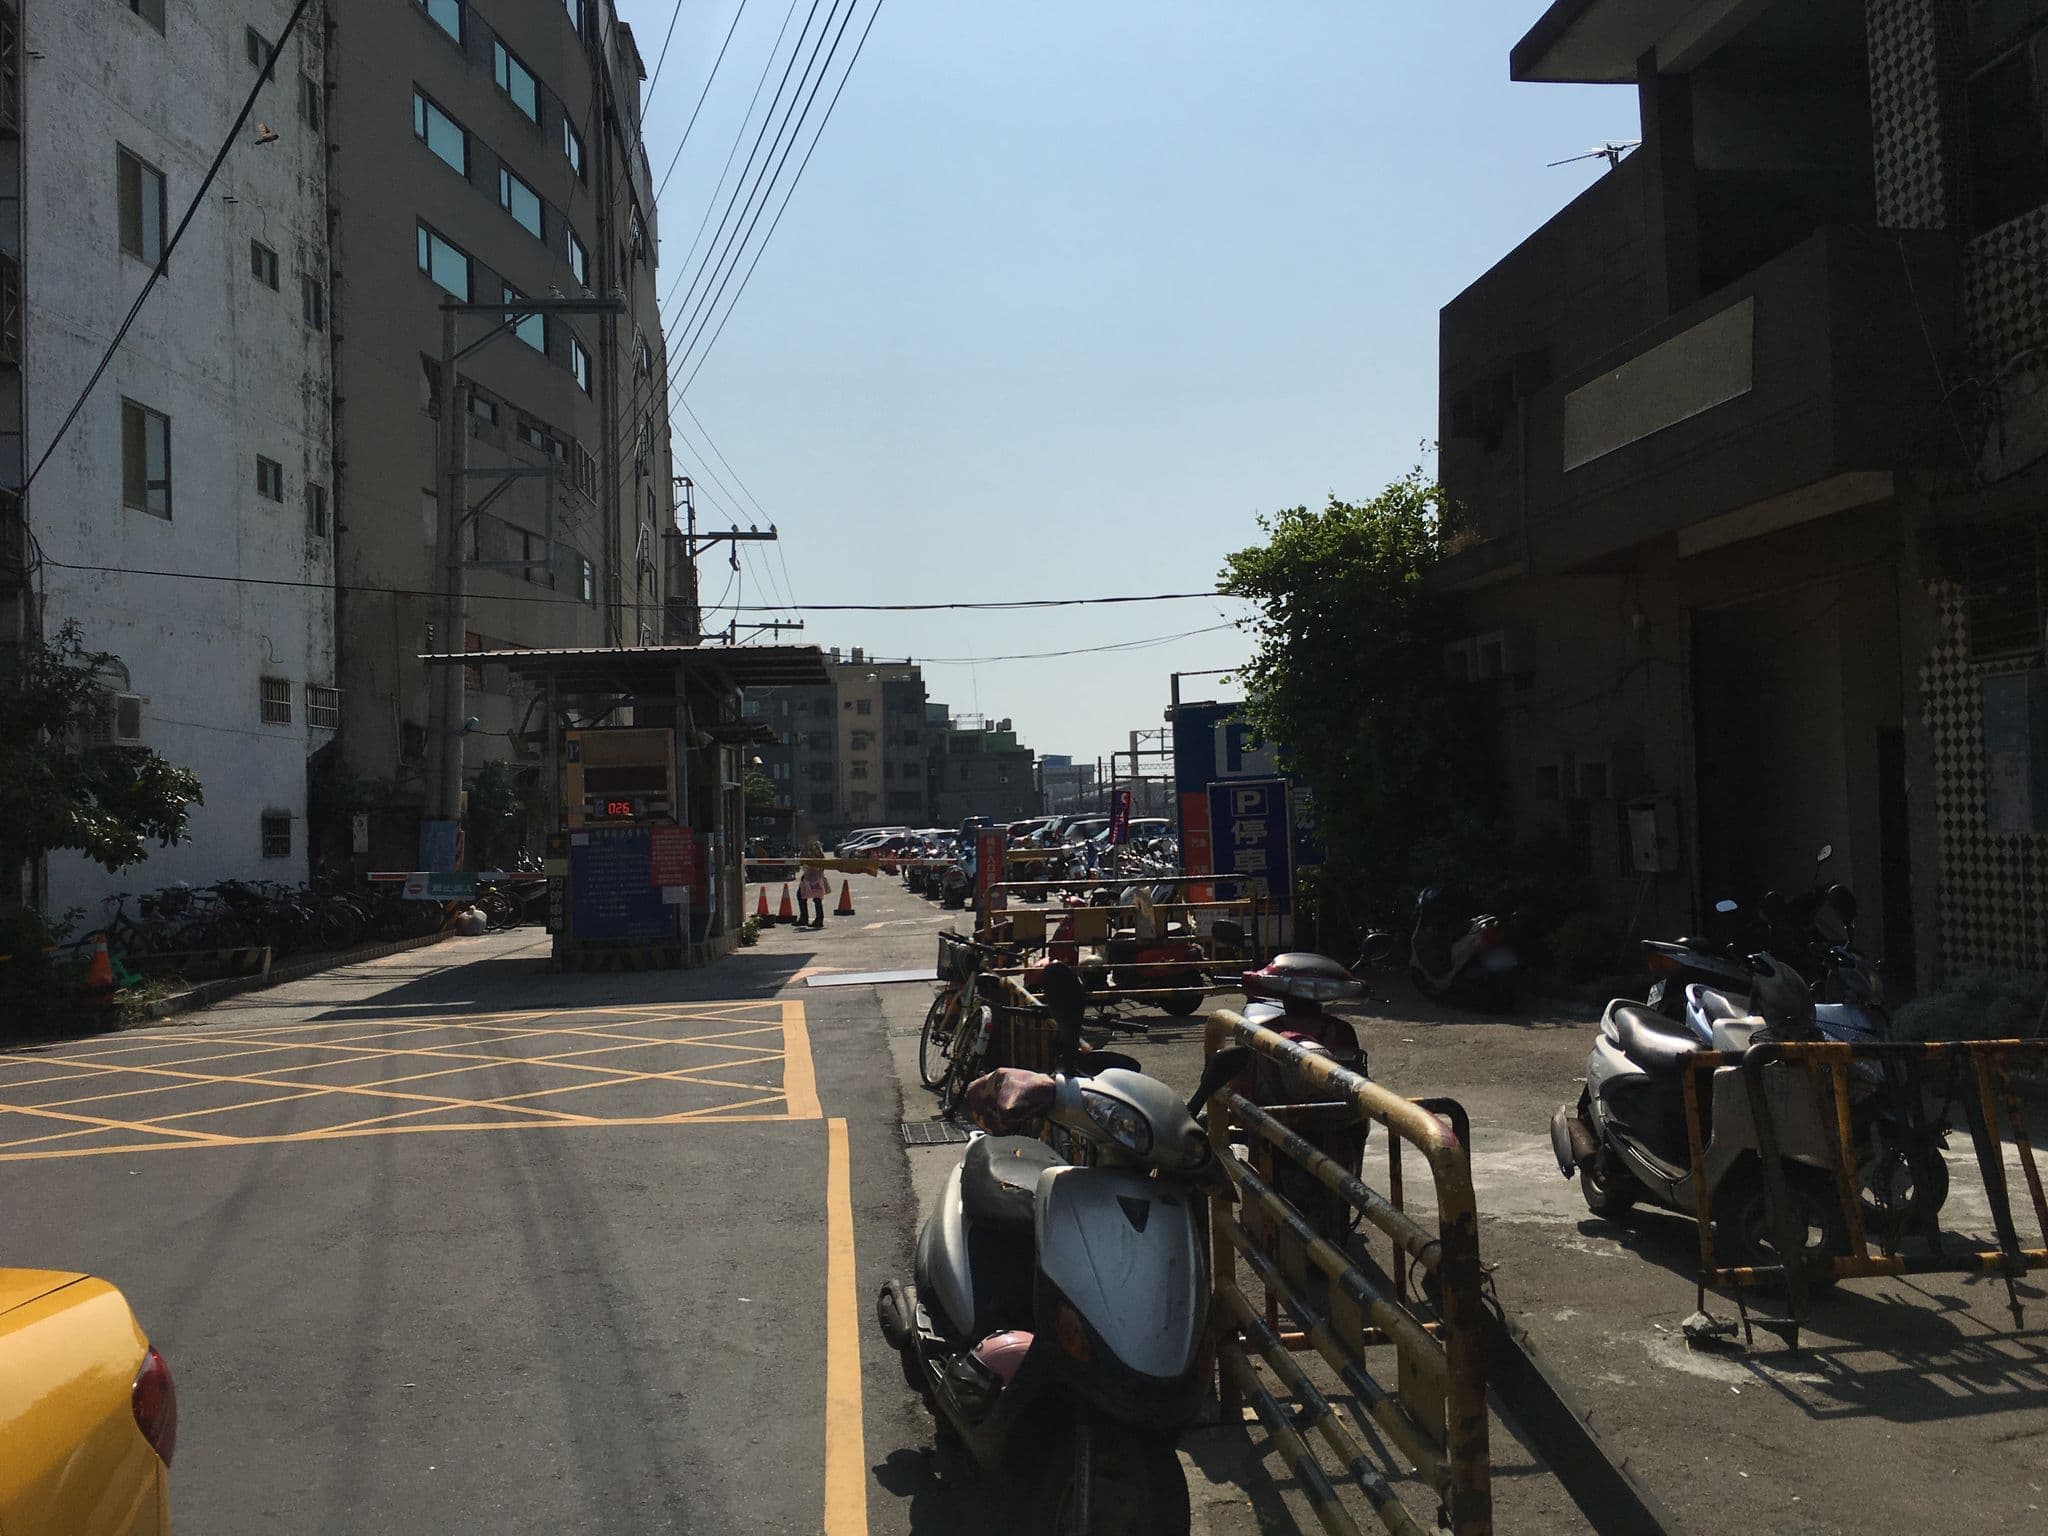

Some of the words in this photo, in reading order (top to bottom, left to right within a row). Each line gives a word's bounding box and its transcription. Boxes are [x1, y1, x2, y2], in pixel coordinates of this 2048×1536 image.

[1226, 724, 1264, 772] P
[608, 802, 631, 815] 026
[1236, 790, 1262, 814] P
